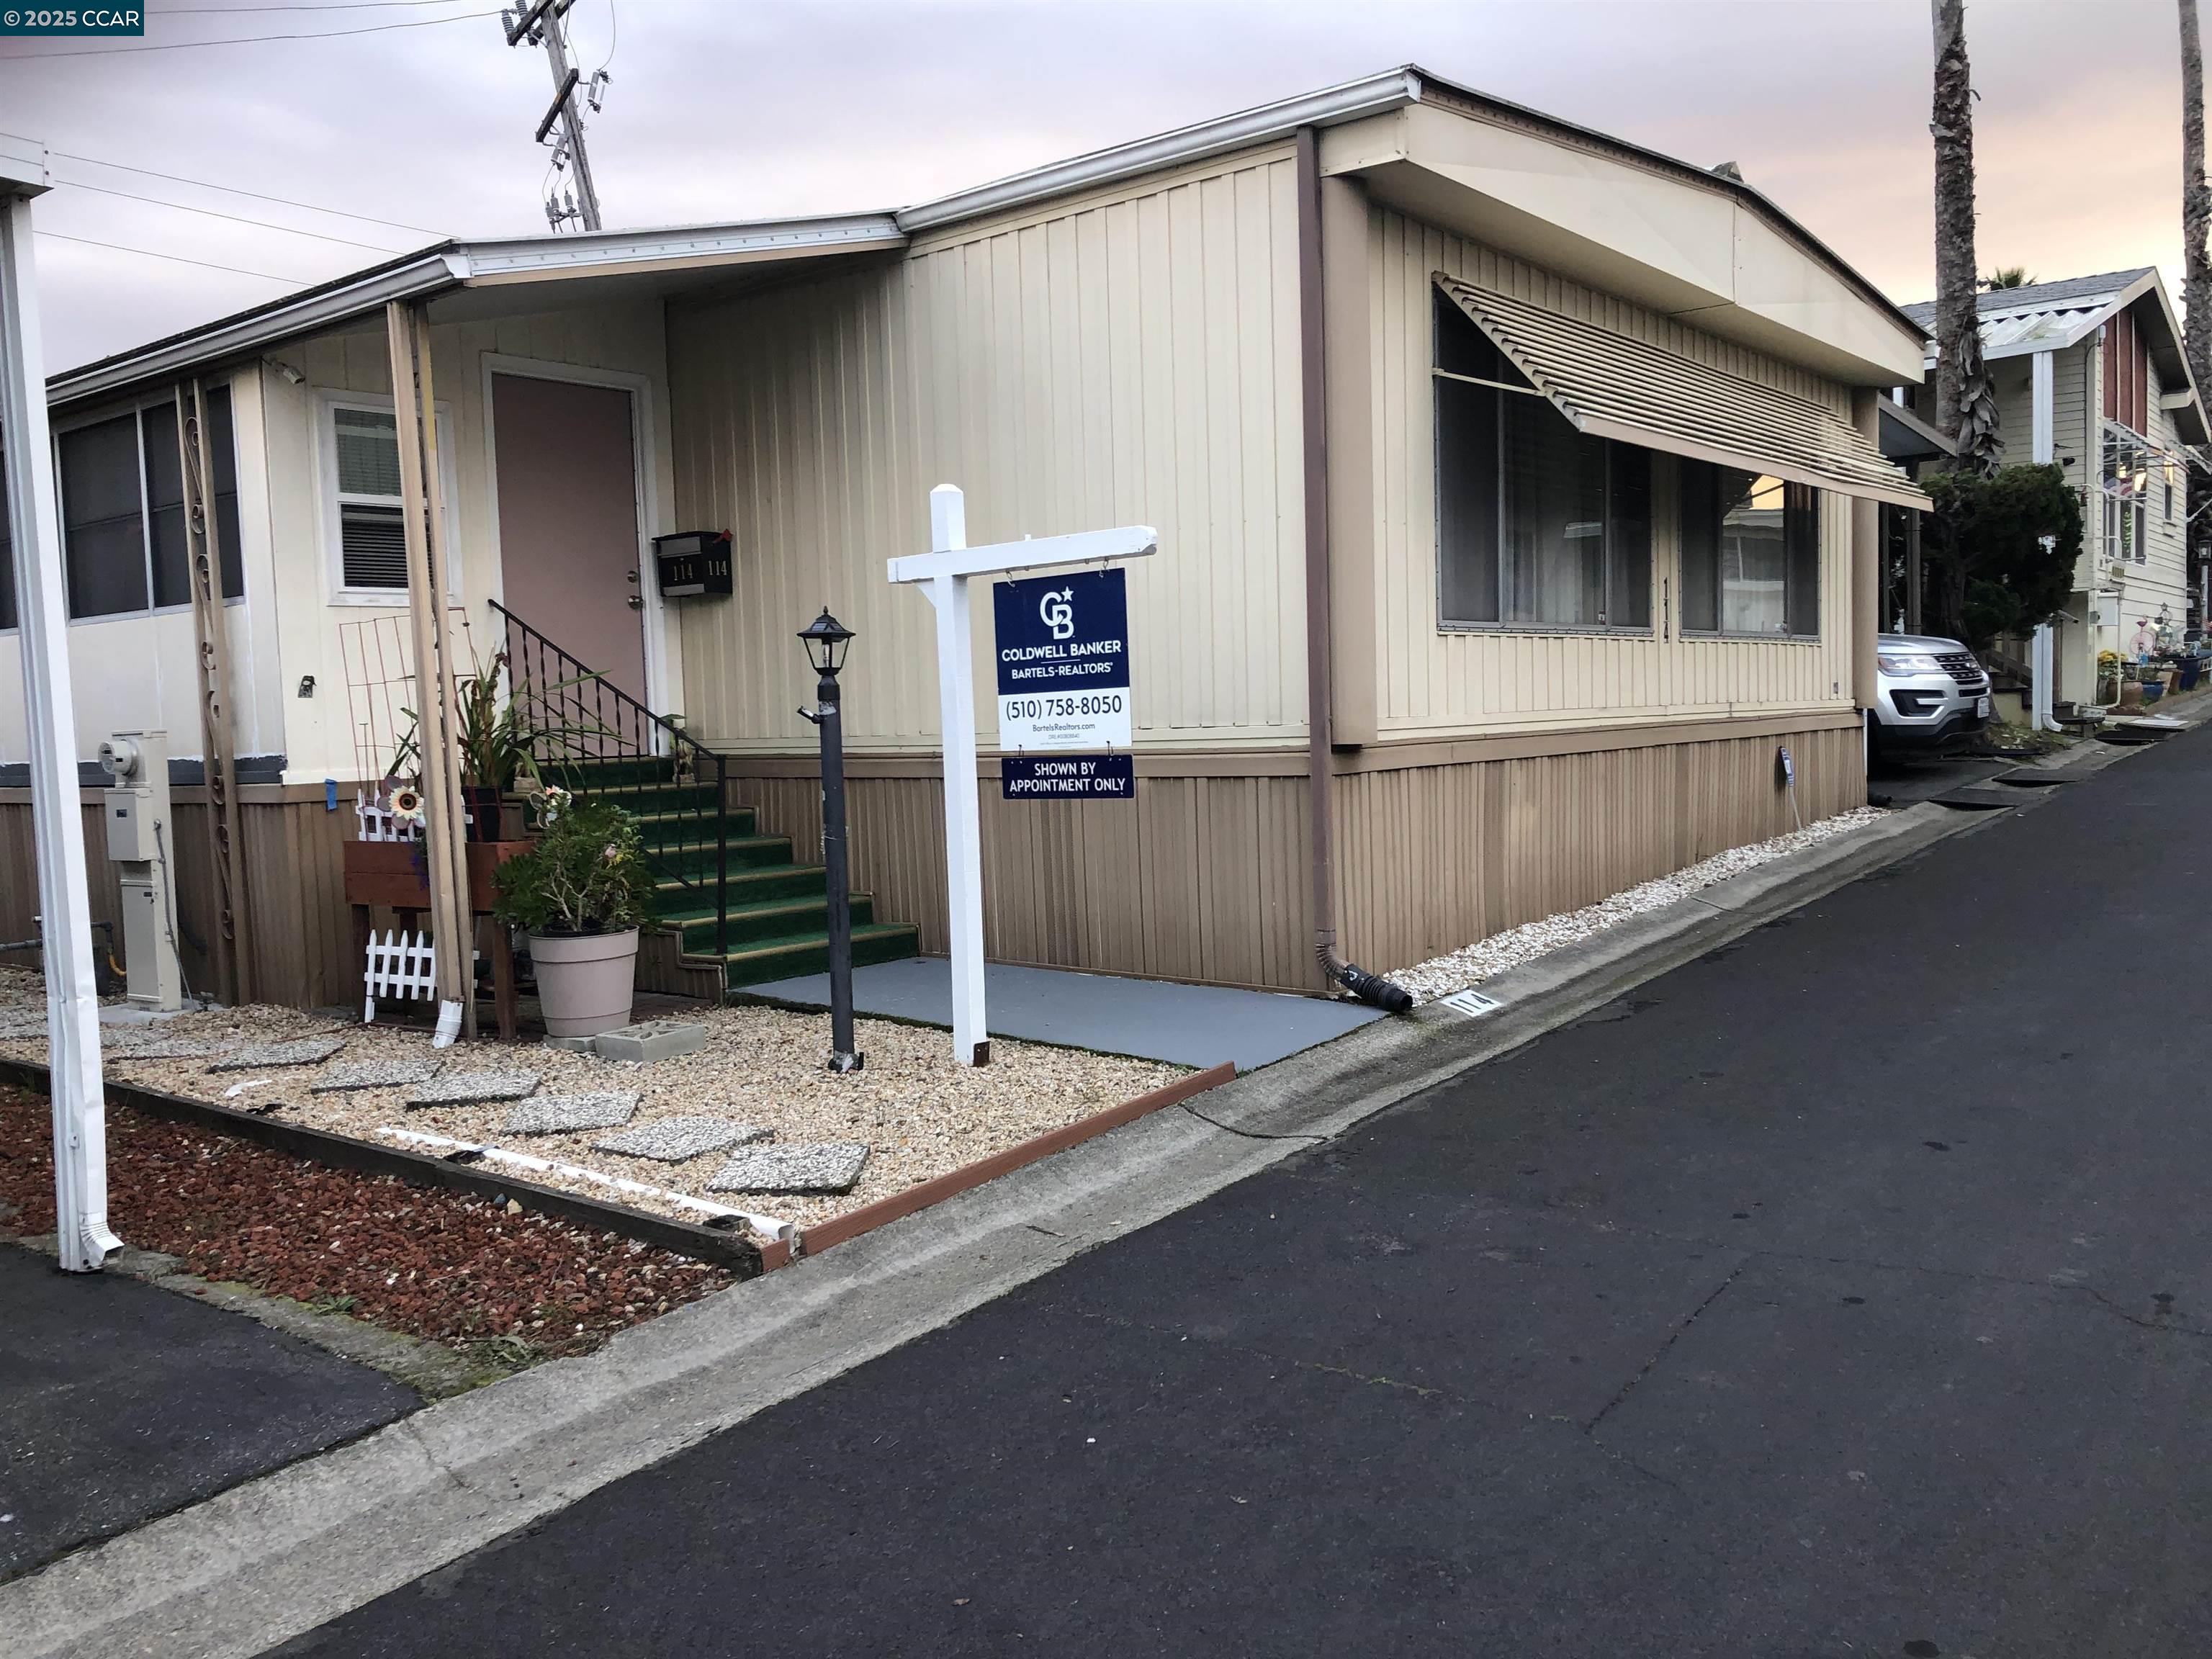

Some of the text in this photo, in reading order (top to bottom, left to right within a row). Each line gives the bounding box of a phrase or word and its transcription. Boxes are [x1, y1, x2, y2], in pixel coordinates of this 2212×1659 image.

[709, 560, 727, 576] 114
[1001, 639, 1122, 662] COLDWELL BANKER
[1006, 695, 1122, 721] (510) 758-8050
[1032, 722, 1096, 732] BartelsRealtors.com
[1034, 761, 1097, 776] SHOWN BY
[1009, 777, 1126, 793] APPOINTMENT ONLY
[1450, 993, 1496, 1013] 114
